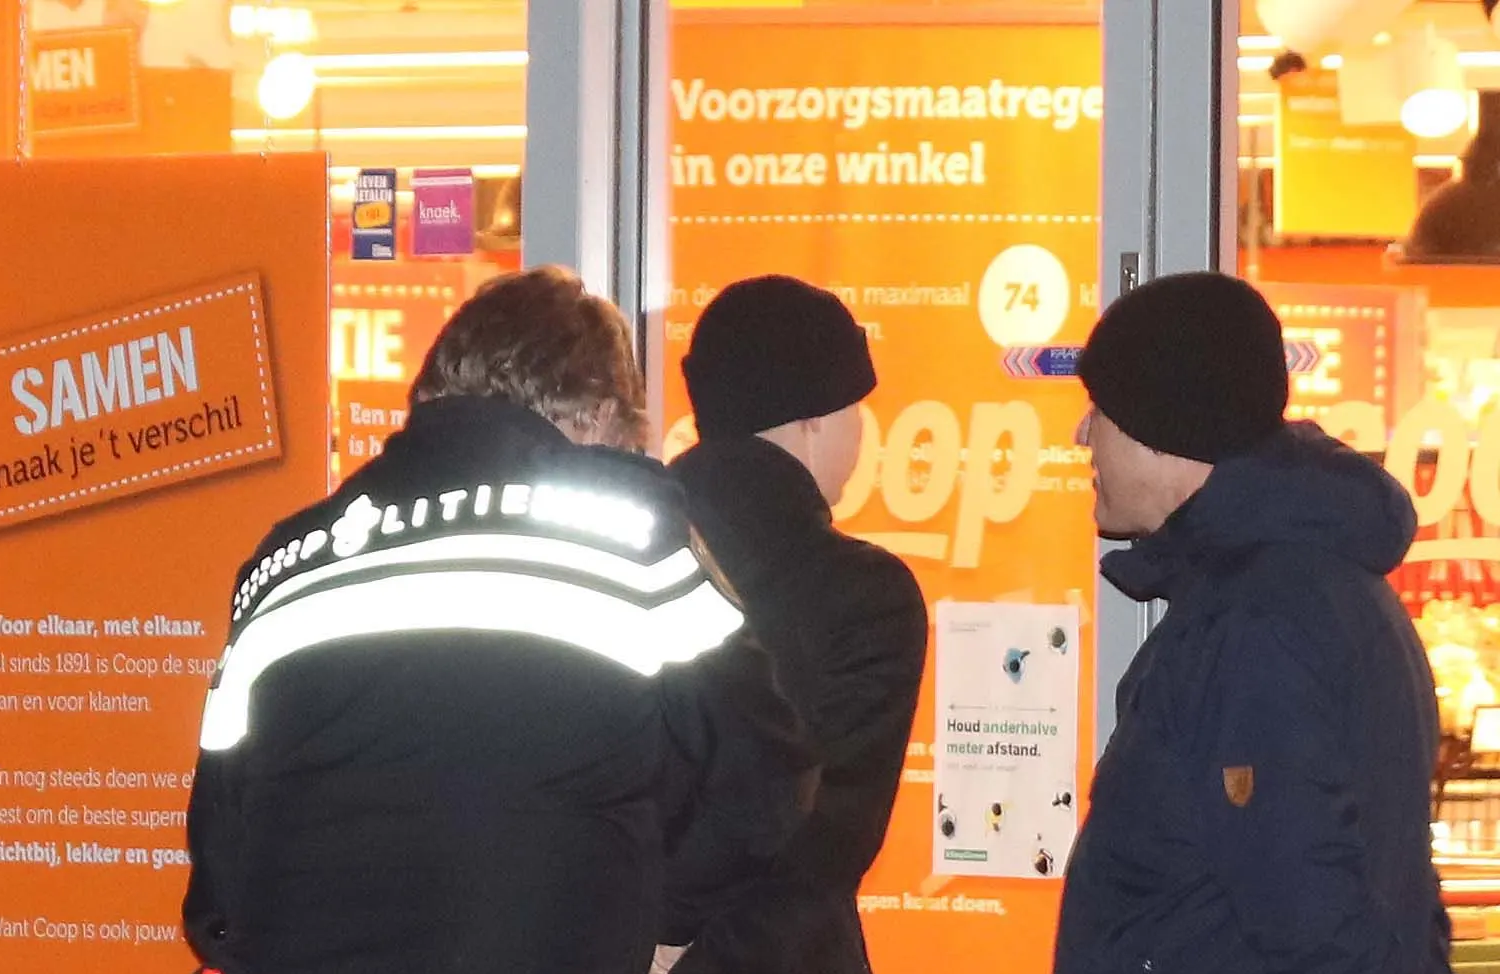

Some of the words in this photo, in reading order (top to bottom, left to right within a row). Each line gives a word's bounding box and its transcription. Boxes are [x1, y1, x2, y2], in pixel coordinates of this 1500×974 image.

[671, 145, 716, 186] in
[725, 151, 828, 185] onze
[836, 142, 987, 186] winkel
[863, 281, 970, 307] maximaal
[1003, 282, 1041, 313] 74
[10, 326, 198, 436] SAMEN
[349, 401, 386, 425] Een
[70, 436, 96, 480] je
[127, 394, 244, 454] verschil
[37, 615, 99, 638] elkaar,
[103, 616, 140, 636] met
[143, 615, 206, 637] elkaar.
[9, 653, 50, 674] sinds
[55, 653, 92, 673] 1891
[96, 654, 109, 674] is
[112, 654, 157, 678] Coop
[162, 653, 183, 674] de
[22, 694, 43, 712] en
[46, 693, 85, 712] voor
[88, 690, 152, 713] klanten.
[946, 718, 980, 733] Houd
[982, 720, 1058, 737] anderhalve
[946, 741, 984, 755] meter
[986, 741, 1042, 758] afstand.
[13, 770, 46, 792] nog
[49, 767, 101, 788] steeds
[105, 769, 148, 789] doen
[151, 773, 177, 789] we
[25, 807, 53, 825] om
[57, 804, 79, 825] de
[83, 804, 127, 826] beste
[66, 841, 121, 864] lekker
[124, 846, 150, 864] en
[33, 917, 78, 943] Coop
[82, 918, 95, 939] is
[99, 918, 132, 941] ook
[133, 921, 178, 946] jouw
